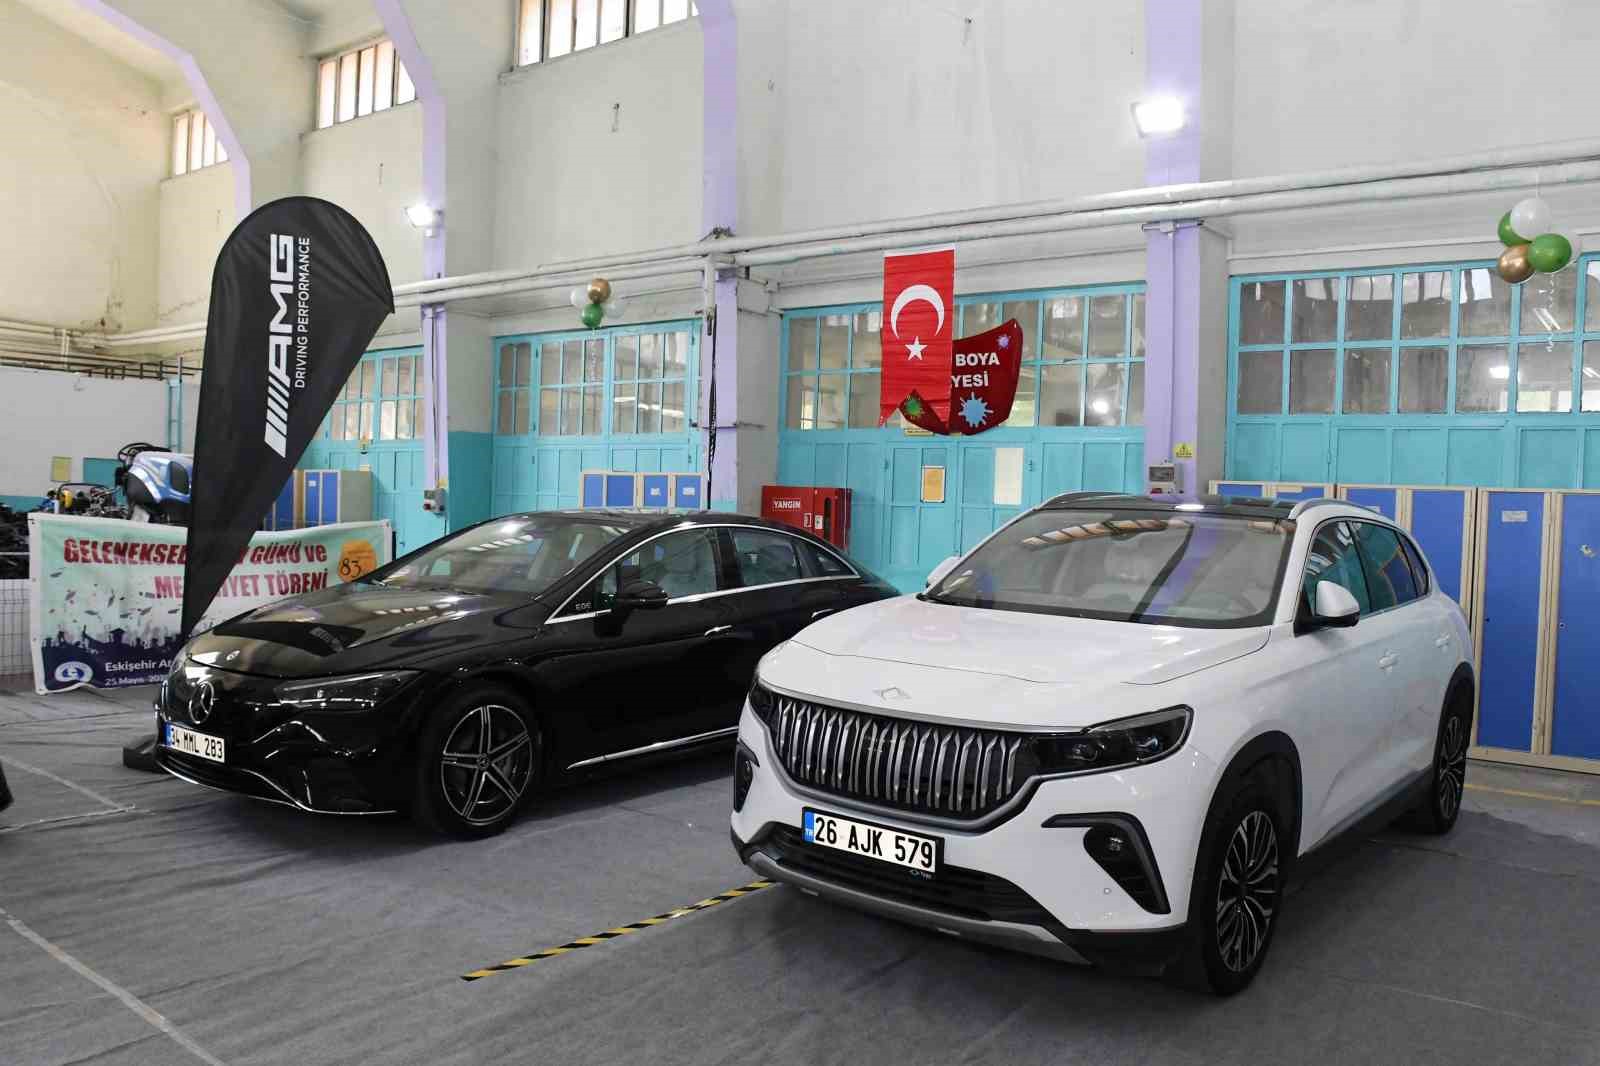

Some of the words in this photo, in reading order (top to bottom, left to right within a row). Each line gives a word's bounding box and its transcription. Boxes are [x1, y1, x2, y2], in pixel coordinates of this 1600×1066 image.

[297, 236, 311, 333] PERFORMANCE
[267, 233, 294, 388] AMG
[295, 333, 309, 389] DRIVING
[956, 352, 1000, 367] BOYA
[950, 370, 989, 387] YESİ
[774, 500, 801, 509] YANGIN
[250, 540, 302, 564] GÜNÜ
[304, 543, 328, 563] ve
[264, 567, 328, 596] TÖRENİ
[105, 659, 157, 672] Eskişehir
[183, 730, 199, 753] MML
[204, 737, 223, 759] 283
[815, 817, 837, 844] 26
[847, 825, 883, 857] AJK
[894, 835, 933, 869] 579
